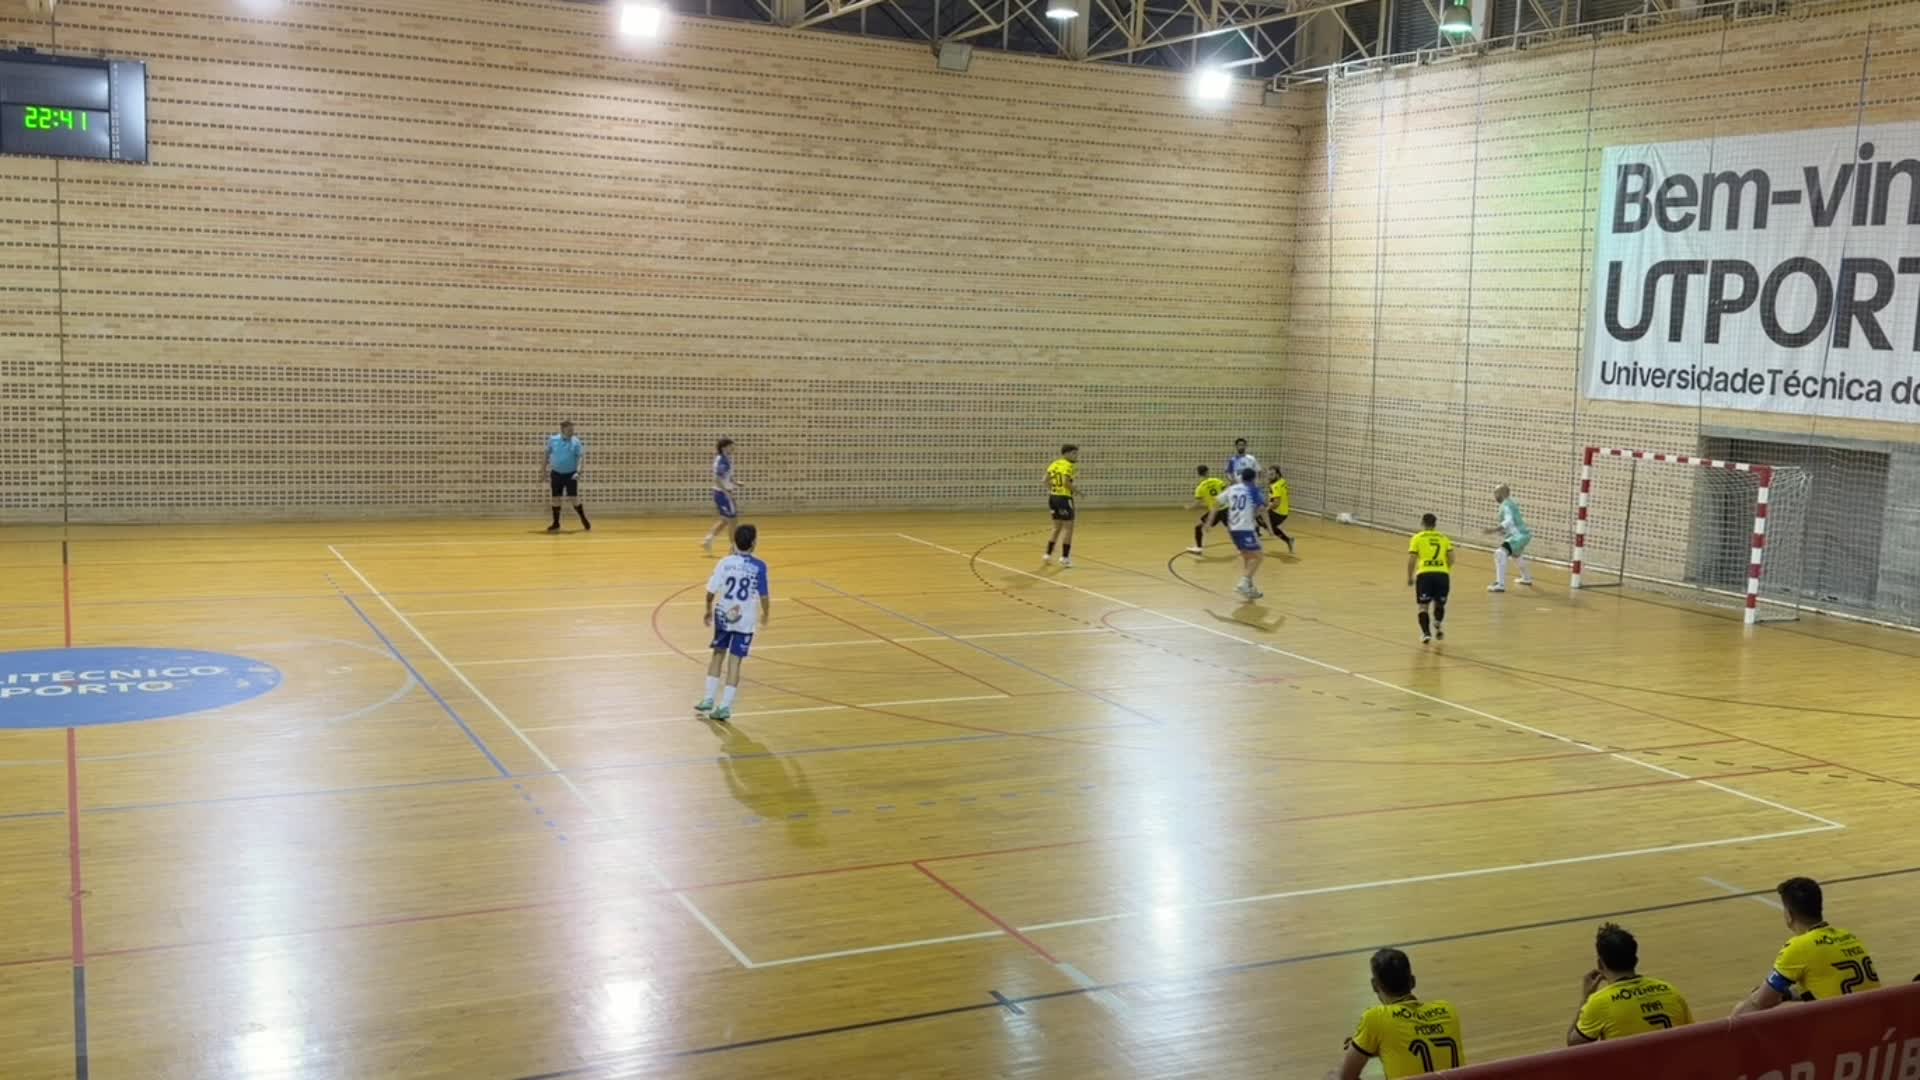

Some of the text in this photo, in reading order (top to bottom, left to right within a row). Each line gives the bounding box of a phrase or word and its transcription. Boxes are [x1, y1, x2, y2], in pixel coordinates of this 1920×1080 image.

[24, 106, 87, 131] 22:41
[1612, 142, 1920, 234] Bem-vin
[1429, 542, 1441, 561] 7
[724, 576, 751, 602] 28
[0, 680, 173, 698] PORTO
[1414, 1023, 1445, 1036] PEDRO
[1408, 1036, 1460, 1073] 17
